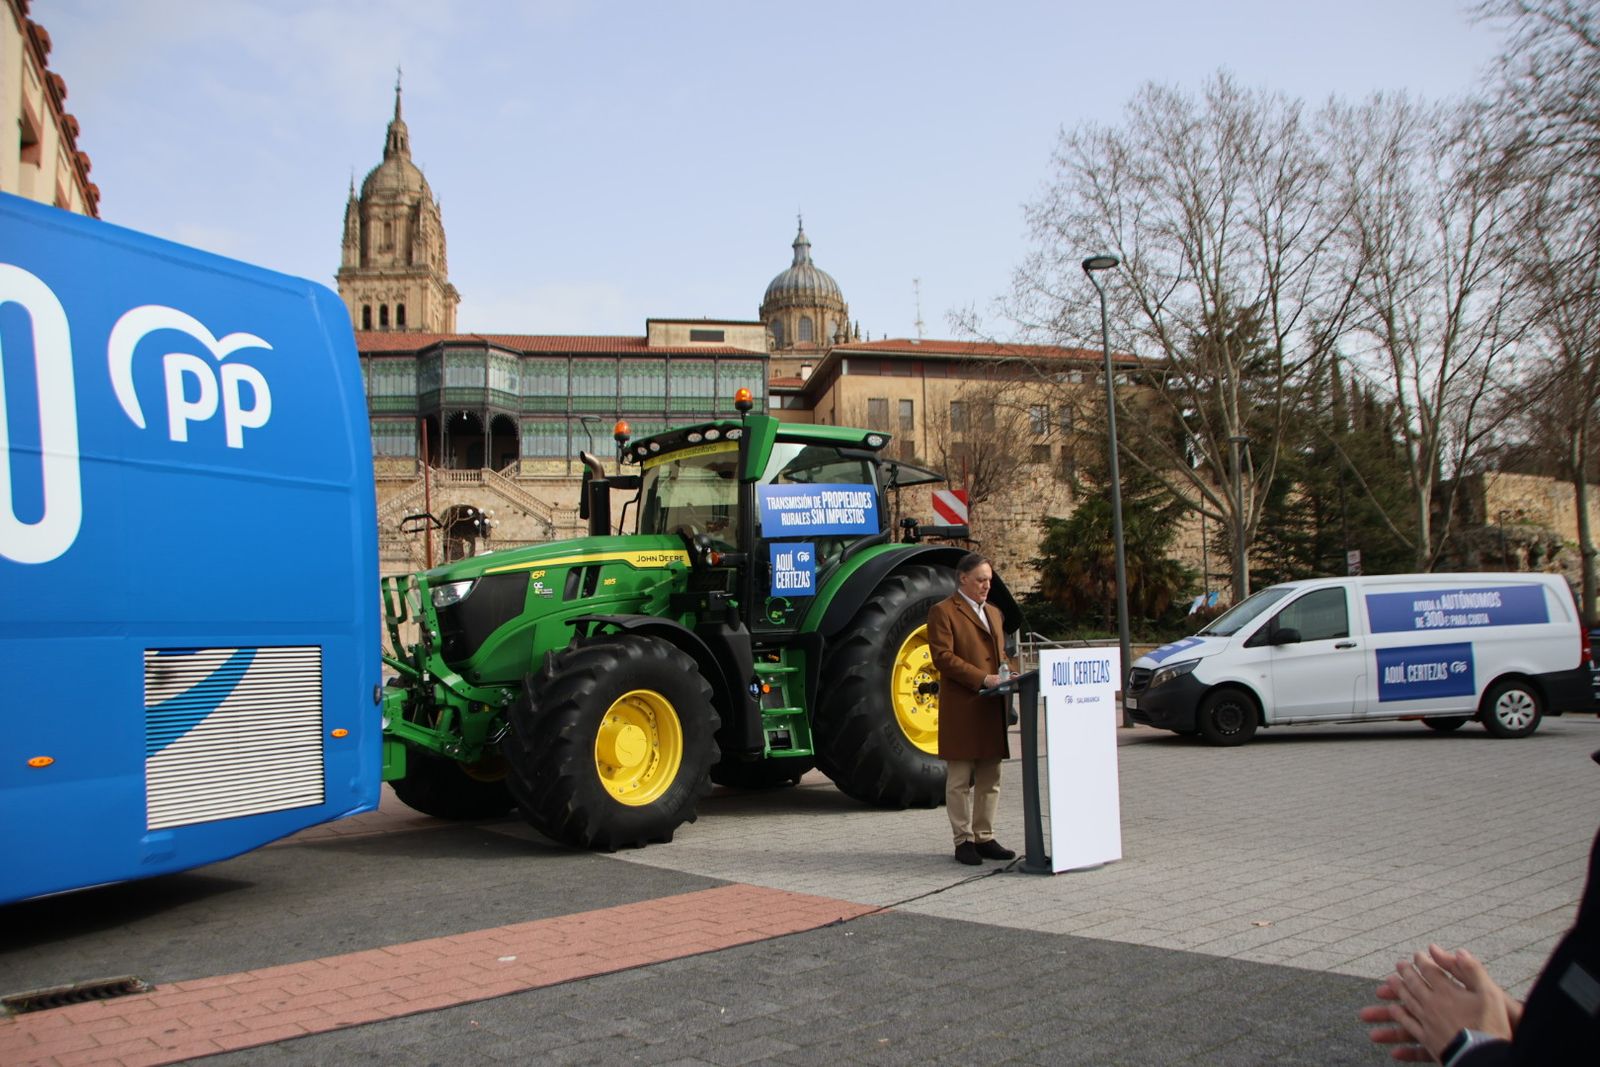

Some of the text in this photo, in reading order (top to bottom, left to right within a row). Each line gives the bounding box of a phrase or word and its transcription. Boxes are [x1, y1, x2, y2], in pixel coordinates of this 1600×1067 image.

[766, 491, 872, 510] TRANSMISIÓN DE PROPIEDADES
[781, 509, 865, 526] RURALES SIN IMPUESTOS
[636, 554, 684, 563] JOHN DEERE
[776, 550, 795, 572] AQUÍ,
[531, 570, 546, 579] 6R
[776, 571, 810, 589] CERTEZAS
[1441, 590, 1502, 609] AUTÓNOMOS
[1052, 656, 1110, 687] AQUÍ, CERTEZAS
[1407, 662, 1448, 683] CERTEZAS
